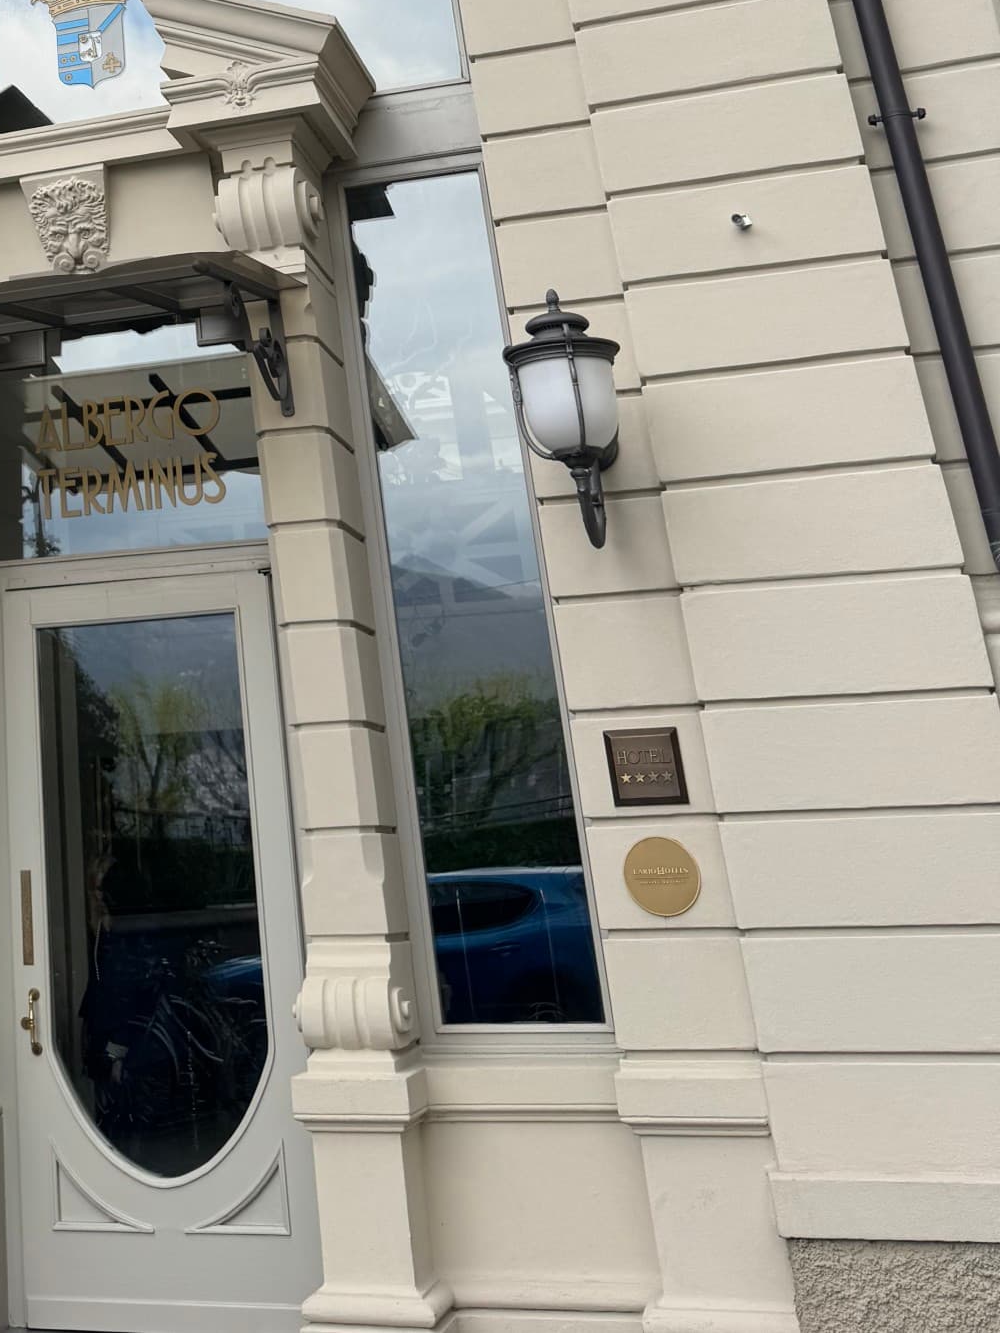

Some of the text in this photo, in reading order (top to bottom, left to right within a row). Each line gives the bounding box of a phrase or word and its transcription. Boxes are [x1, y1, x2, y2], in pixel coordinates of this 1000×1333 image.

[36, 387, 221, 454] ALBERGO
[39, 452, 227, 520] TERMINUS
[616, 748, 672, 765] HOTEL
